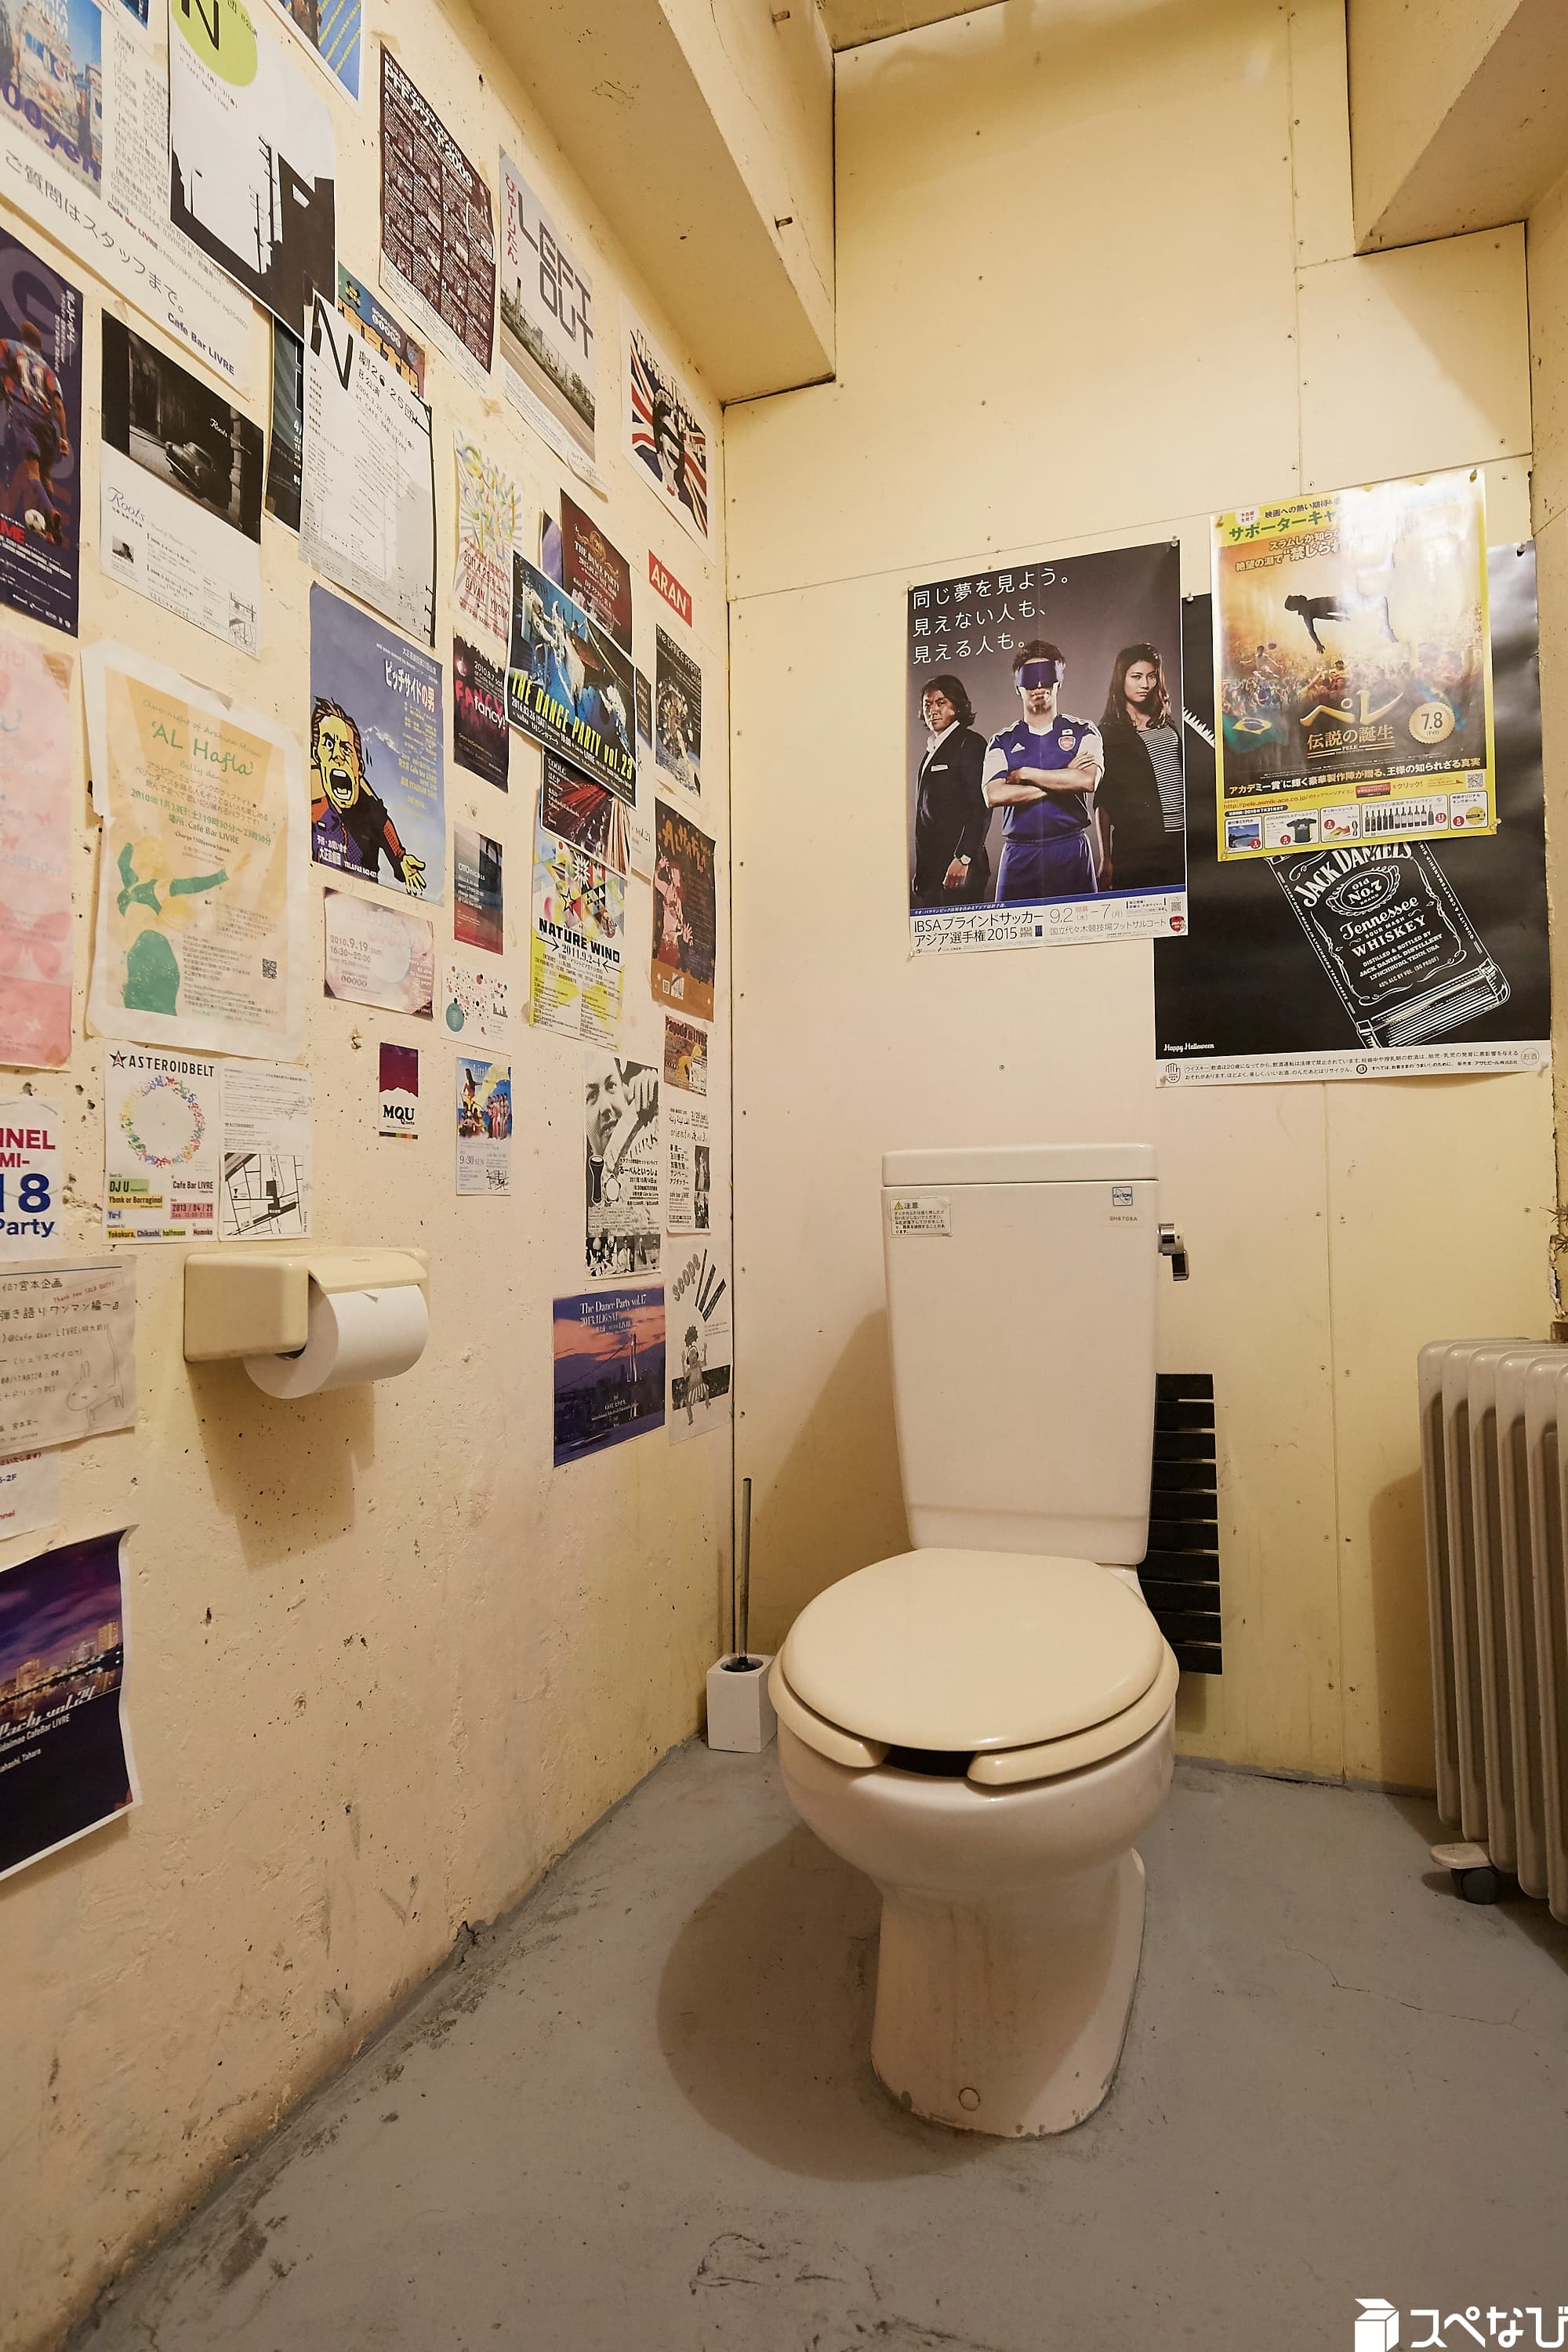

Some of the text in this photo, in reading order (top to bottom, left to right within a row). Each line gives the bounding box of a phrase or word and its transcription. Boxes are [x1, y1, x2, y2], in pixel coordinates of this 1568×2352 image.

[384, 60, 474, 188] PFFアワード2009
[517, 191, 591, 321] LEFT
[539, 260, 593, 360] OUT
[168, 312, 235, 376] Cafe Bar LIVRE
[107, 486, 145, 521] Roots
[650, 563, 687, 615] ARAN
[913, 566, 1069, 610] 同じ夢を見よう。
[913, 600, 1046, 637] 見えない人も、
[913, 632, 1025, 666] 見える人も。
[384, 658, 436, 714] ピッチサイドの男
[474, 696, 506, 731] fancy!
[511, 671, 633, 781] THE DANCE PARTY vol.23
[1299, 689, 1404, 728] ペレ
[1420, 710, 1444, 731] 7.8
[1306, 724, 1394, 751] 伝説の誕生
[1294, 861, 1344, 908] JACK
[1424, 855, 1456, 907] CRAFTSMANSHIP
[1050, 906, 1074, 924] 9.2
[1359, 893, 1380, 906] BRAND
[915, 926, 1018, 948] アジア選手権2015
[1340, 897, 1419, 941] Tennessee
[1351, 914, 1427, 958] WHISKEY
[1365, 916, 1405, 940] SOUR MASH
[1457, 911, 1475, 940] QUALITY
[330, 935, 368, 951] 2010.9.19
[539, 917, 621, 964] NATURE WIND
[1300, 914, 1311, 933] MADE
[1311, 938, 1332, 971] LYNCHBURG
[1329, 967, 1349, 1000] TENNESSEE
[1359, 933, 1443, 978] JACK DANIEL DISTILLERY
[1362, 951, 1391, 967] DISTILLED
[1396, 935, 1422, 952] BOTTLED
[1422, 930, 1432, 940] BY
[1369, 960, 1408, 981] LYNCHBURG,
[1426, 944, 1440, 955] USA
[1388, 975, 1398, 985] ALC
[1163, 1041, 1215, 1053] Happy Halloween
[1523, 1053, 1538, 1062] お酒
[129, 1054, 215, 1078] ASTEROIDBELT
[110, 1181, 129, 1192] DJ U
[172, 1181, 213, 1189] Cafe Bar LIVRE
[580, 1301, 595, 1315] The
[595, 1299, 615, 1312] Dance
[615, 1297, 630, 1311] Party
[52, 1713, 71, 1730] LIVRE
